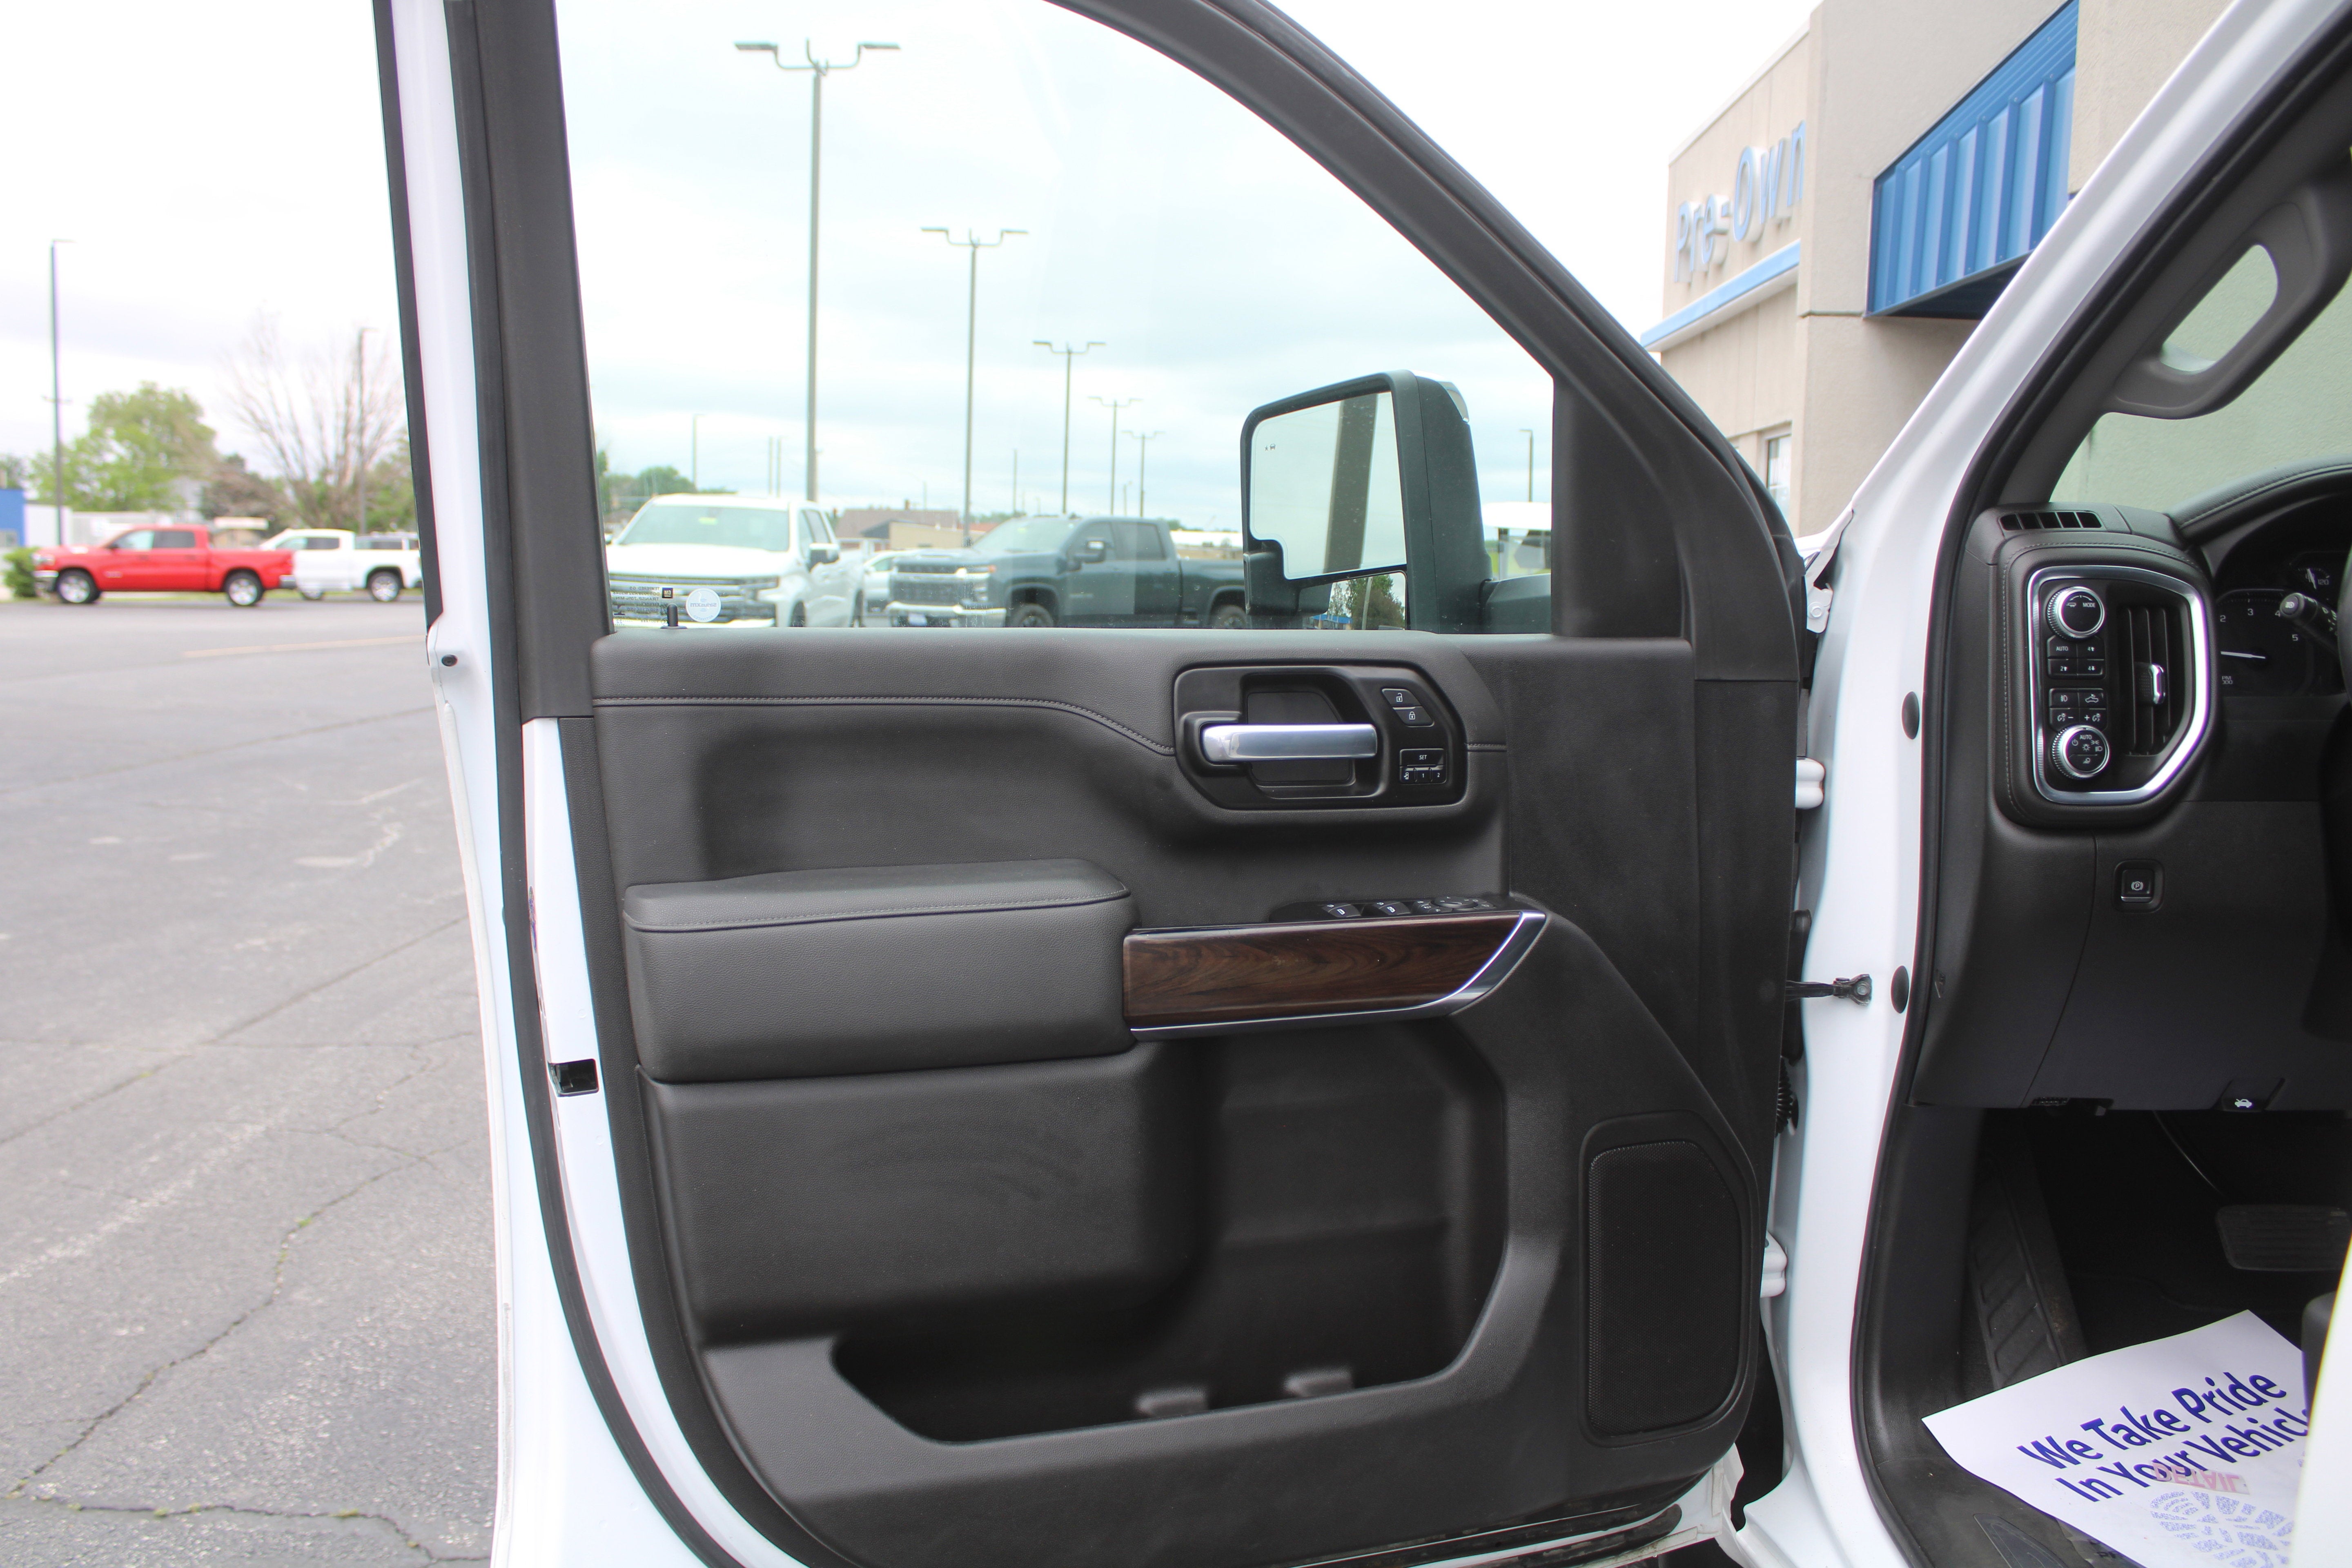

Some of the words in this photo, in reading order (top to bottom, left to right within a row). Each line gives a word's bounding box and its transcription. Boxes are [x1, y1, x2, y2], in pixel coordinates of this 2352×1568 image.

[2016, 1435, 2104, 1469] We
[2080, 1405, 2191, 1451] Take
[2171, 1372, 2287, 1423] Pride
[2054, 1477, 2125, 1502] In
[2095, 1450, 2209, 1488] Your
